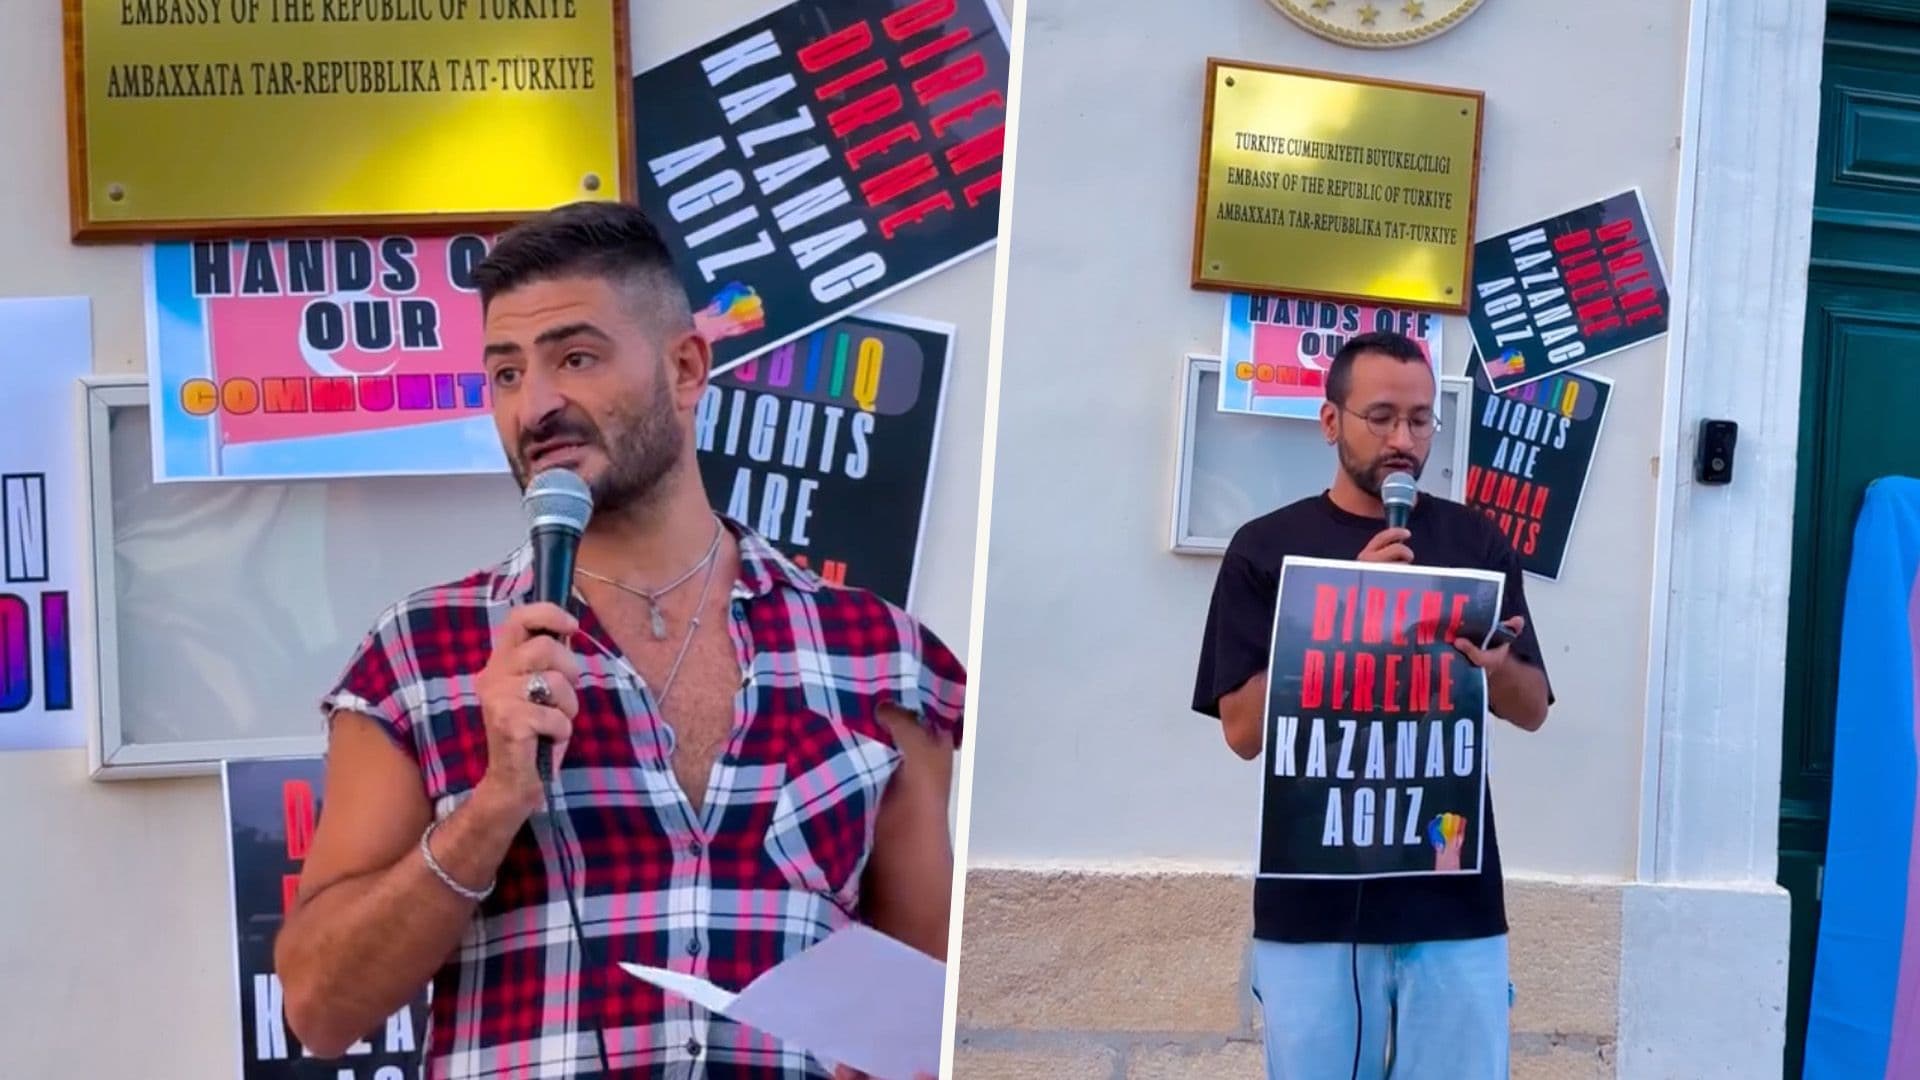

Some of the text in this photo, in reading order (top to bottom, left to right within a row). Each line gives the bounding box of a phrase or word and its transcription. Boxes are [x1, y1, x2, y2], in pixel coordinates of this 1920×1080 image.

[121, 0, 221, 25] EMBASSY
[231, 0, 260, 24] OF
[272, 0, 315, 23] THE
[323, 0, 433, 23] REPUBLIC
[440, 0, 468, 21] OF
[107, 63, 244, 98] AMBAXXATA
[251, 60, 441, 96] TAR-REPUBBLIKA
[796, 20, 955, 240] DIRENE
[700, 29, 886, 303] KAZANAC
[1227, 166, 1280, 190] EMBASSY
[1282, 173, 1299, 192] OF
[1301, 175, 1325, 195] THE
[1327, 178, 1382, 201] REPUBLIC
[1384, 185, 1401, 203] OF
[647, 135, 777, 283] AGIZ
[1216, 201, 1285, 227] AMBAXXATA
[1288, 209, 1381, 237] TAR-REPUBBLIKA
[192, 237, 419, 297] HANDS
[1507, 227, 1586, 364] KAZANAC
[304, 299, 441, 351] OUR
[1249, 295, 1360, 332] HANDS
[1300, 331, 1347, 357] OU
[179, 373, 486, 417] COMMUNIT
[1481, 394, 1572, 450] RIGHTS
[695, 384, 876, 479] RIGHTS
[1491, 436, 1541, 479] ARE
[726, 467, 820, 547] ARE
[1310, 583, 1472, 646] DIRENE
[1301, 648, 1456, 713] DIRENE
[1273, 715, 1475, 780] KAZANAC
[1321, 786, 1425, 847] AGIZ
